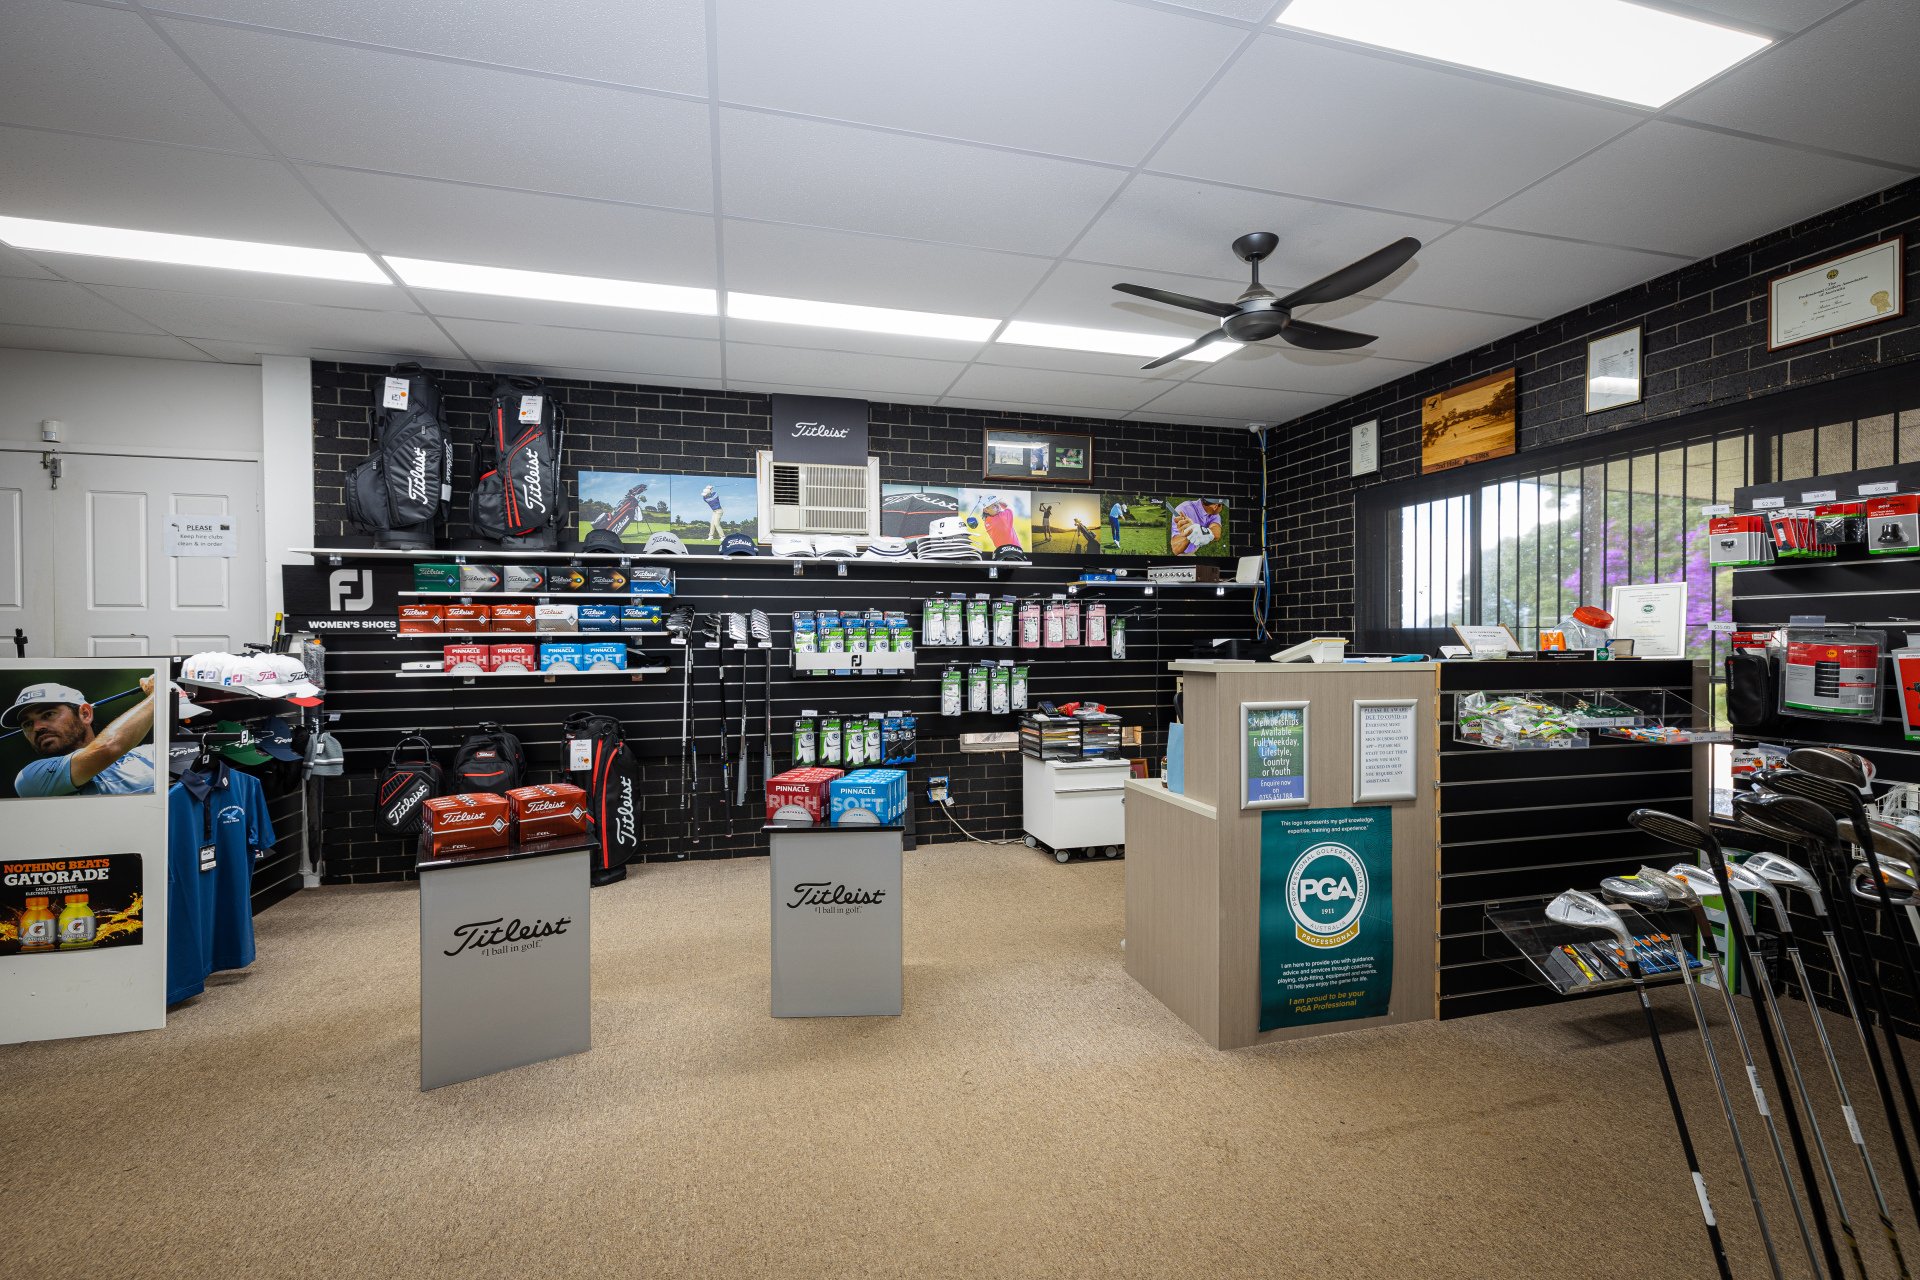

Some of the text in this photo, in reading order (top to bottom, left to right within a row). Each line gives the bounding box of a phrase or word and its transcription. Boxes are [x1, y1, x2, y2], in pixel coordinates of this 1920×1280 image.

[792, 422, 850, 438] Titleist
[409, 447, 426, 506] Titleist
[526, 448, 546, 513] Titleist
[329, 570, 373, 612] FJ
[402, 608, 429, 617] Titleist
[308, 620, 396, 630] WOMEN'S SHOES
[447, 655, 486, 665] RUSH
[492, 655, 532, 665] RUSH
[542, 655, 582, 665] SOFT
[584, 654, 624, 665] SOFT
[851, 655, 862, 667] FJ
[233, 674, 242, 682] FJ
[1253, 718, 1299, 727] Memberships
[241, 730, 248, 743] FJ
[1260, 728, 1292, 737] Available
[1261, 747, 1292, 757] Lifestyle,
[203, 754, 209, 764] FJ
[1263, 757, 1289, 767] Country
[1271, 767, 1291, 776] Youth
[388, 784, 427, 826] Titleist
[525, 800, 566, 813] Titleist
[769, 794, 817, 810] RUSH
[832, 797, 884, 812] SOFT
[615, 775, 637, 846] Titleist
[440, 810, 486, 825] Titleist
[4, 859, 110, 873] NOTHING BEATS
[4, 868, 109, 886] GATORADE
[1291, 848, 1364, 906] PROFESSIONAL GOLFERS ASSOCIATION
[787, 882, 884, 909] Titleist
[1300, 877, 1355, 902] PGA
[822, 906, 836, 914] ball
[29, 922, 45, 936] G
[68, 920, 84, 934] G
[1310, 921, 1346, 931] AUSTRALIA
[444, 916, 571, 956] Titleist
[1302, 931, 1354, 944] PROFESSIONAL
[492, 945, 508, 956] ball
[510, 944, 519, 952] in
[1306, 994, 1328, 1005] proud
[1348, 991, 1365, 999] your
[1313, 1000, 1357, 1010] Professional
